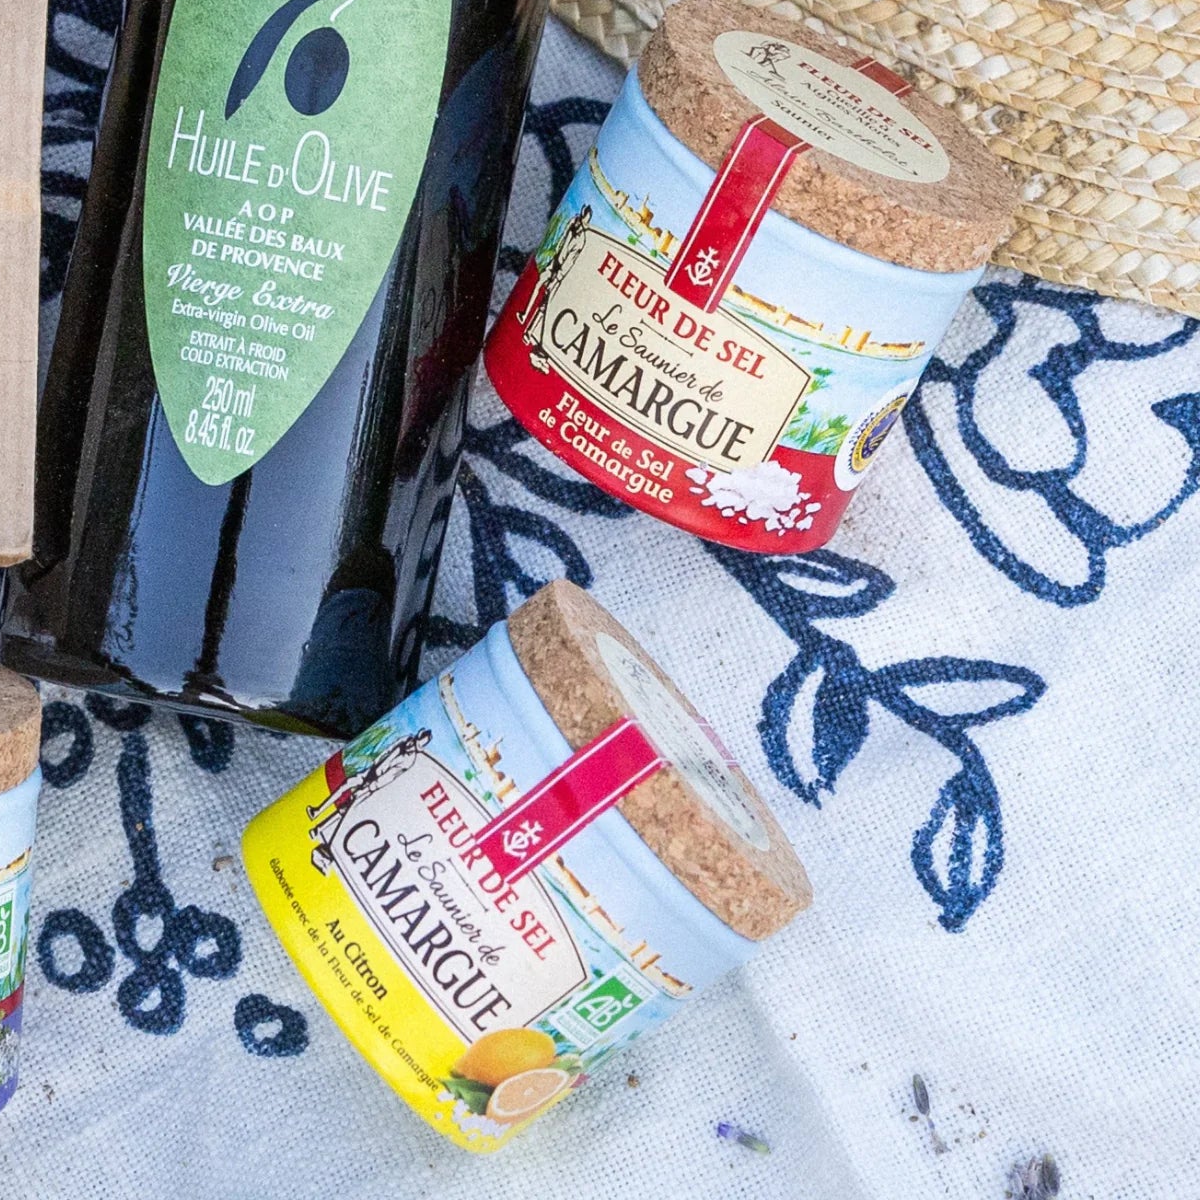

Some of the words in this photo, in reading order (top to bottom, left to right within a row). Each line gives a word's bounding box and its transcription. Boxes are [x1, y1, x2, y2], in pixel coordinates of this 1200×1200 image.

[769, 99, 836, 141] Saunier
[797, 61, 862, 105] FLEUR
[866, 105, 897, 127] DE
[898, 127, 935, 154] SEL
[183, 212, 244, 240] VALLÉE
[249, 226, 286, 248] DES
[291, 235, 345, 260] BAUX
[191, 240, 217, 260] DE
[220, 245, 325, 281] PROVENCE
[167, 263, 244, 305] Vierge
[252, 280, 334, 320] Extra
[172, 299, 246, 329] Extra-virgin
[250, 314, 289, 336] Olive
[292, 323, 316, 341] Oil
[597, 251, 671, 325] FLEUR
[673, 312, 715, 351] DE
[716, 340, 767, 379] SEL
[180, 346, 213, 365] COLD
[215, 353, 289, 381] EXTRACTION
[190, 330, 236, 351] EXTRAIT
[236, 337, 246, 355] À
[248, 342, 287, 363] FROID
[550, 308, 755, 462] CAMARGUE
[592, 304, 623, 335] Le
[619, 326, 697, 389] Saunier
[698, 380, 724, 402] de
[185, 409, 220, 448] 8.45
[219, 415, 232, 450] fl.
[202, 376, 234, 413] 250
[232, 384, 257, 418] ml
[555, 391, 611, 443] Fleur
[611, 438, 633, 459] de
[636, 449, 675, 482] Sel
[538, 408, 557, 428] de
[560, 421, 674, 503] Camargue
[397, 833, 433, 862] Le
[418, 861, 483, 943] Saunier
[478, 943, 506, 966] de
[420, 780, 487, 871] FLEUR
[478, 872, 519, 913] DE
[510, 910, 557, 961] SEL
[325, 918, 346, 943] Au
[344, 941, 389, 1002] Citron
[342, 818, 512, 1032] CAMARGUE
[269, 857, 294, 900] élaborée
[291, 900, 311, 927] avec
[307, 926, 320, 945] de
[317, 941, 329, 958] la
[327, 955, 352, 989] Fleur
[351, 987, 365, 1006] de
[362, 1004, 379, 1026] Sel
[377, 1024, 392, 1041] de
[391, 1037, 440, 1092] Camargue
